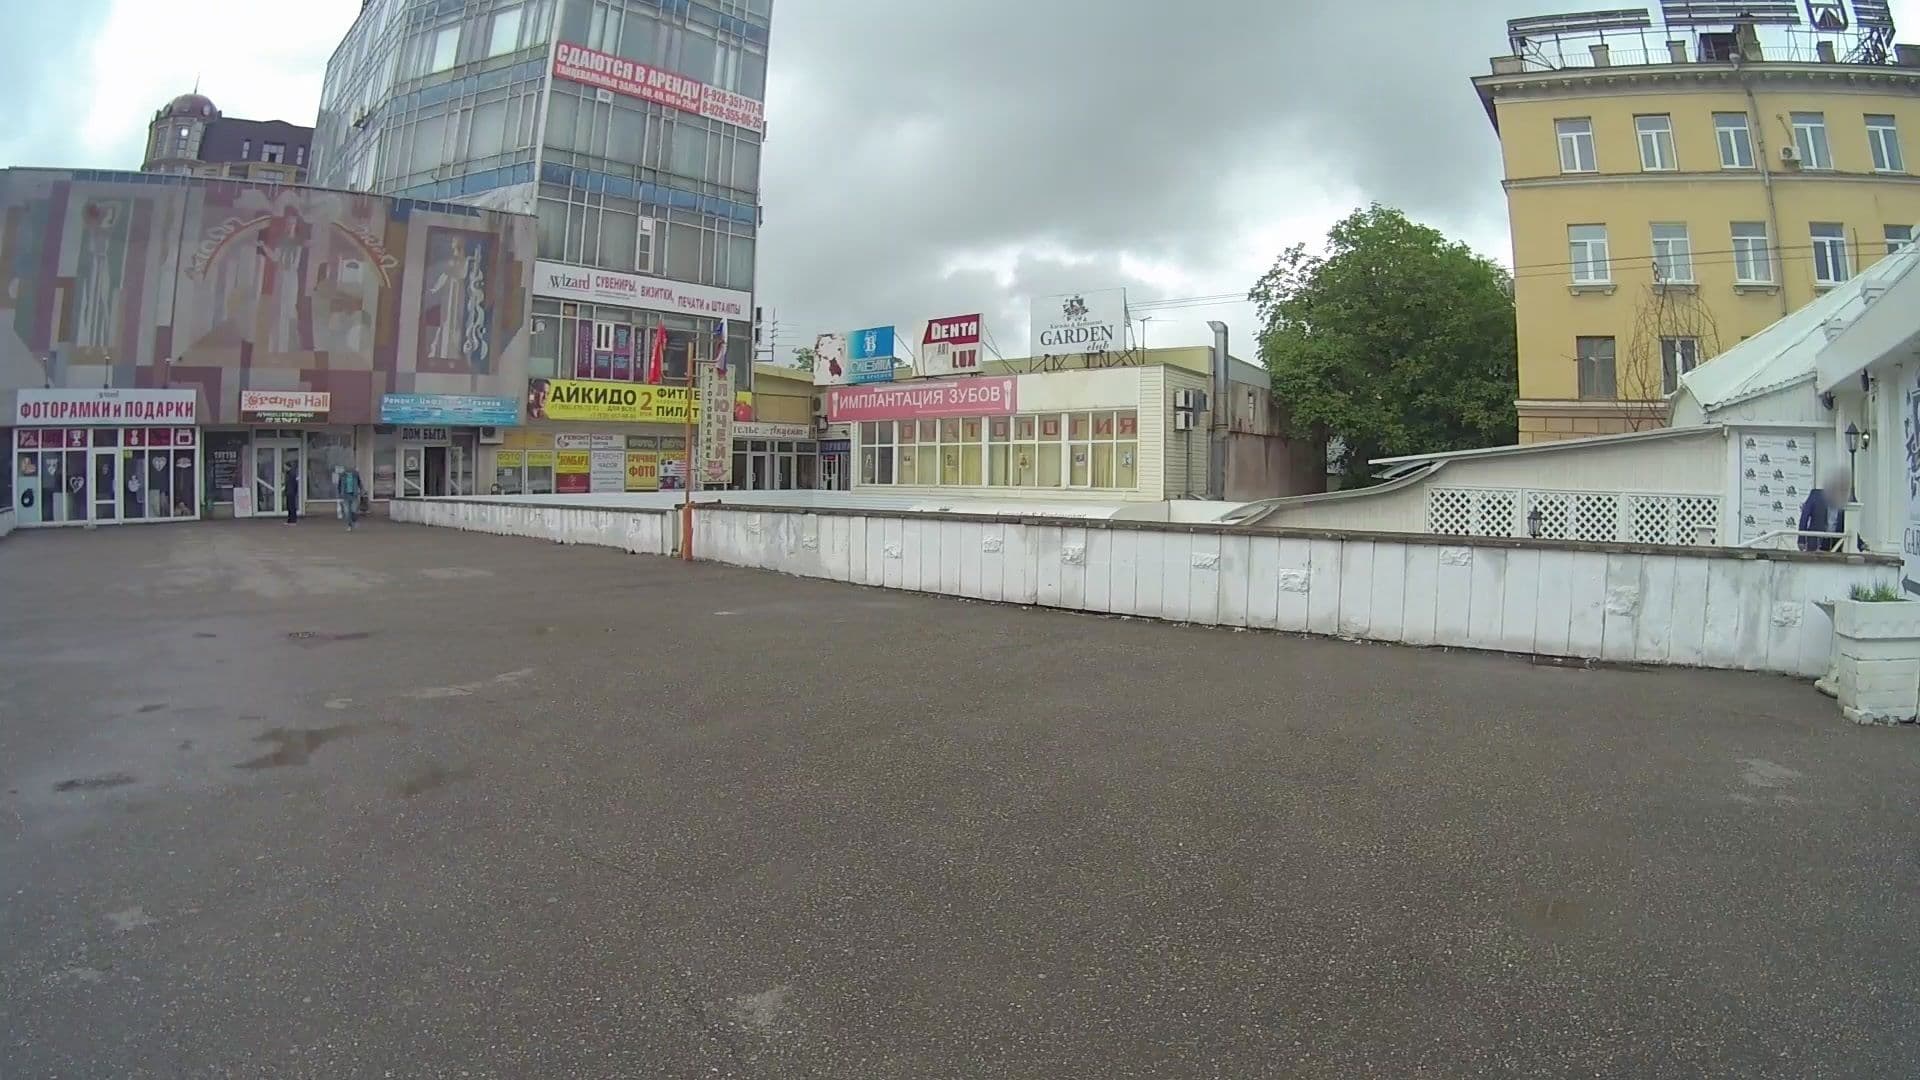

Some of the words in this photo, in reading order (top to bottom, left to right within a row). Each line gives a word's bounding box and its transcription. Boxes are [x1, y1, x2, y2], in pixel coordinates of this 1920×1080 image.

[557, 44, 633, 80] СДАЮТСЯ
[635, 65, 645, 83] В
[648, 69, 700, 101] АРЕНДУ
[678, 296, 705, 310] ПЕЧАТИ
[711, 300, 740, 314] ШТАМПЫ
[1040, 325, 1113, 346] GARDEN
[952, 350, 976, 368] LUX
[304, 394, 328, 407] Hall
[551, 383, 637, 405] АЙКИДО
[640, 391, 652, 410] 2
[839, 391, 943, 409] ИМПЛАНТАЦИЯ
[949, 386, 1000, 404] ЗУБОВ
[20, 401, 110, 418] ФОТОРАМКИ
[113, 404, 121, 417] и
[125, 401, 194, 420] ПОДАРКИ
[714, 367, 730, 460] ЛЮЧЕЙ
[402, 428, 420, 441] ДОМ
[423, 428, 447, 441] БЫТА
[628, 465, 656, 477] ФОТО
